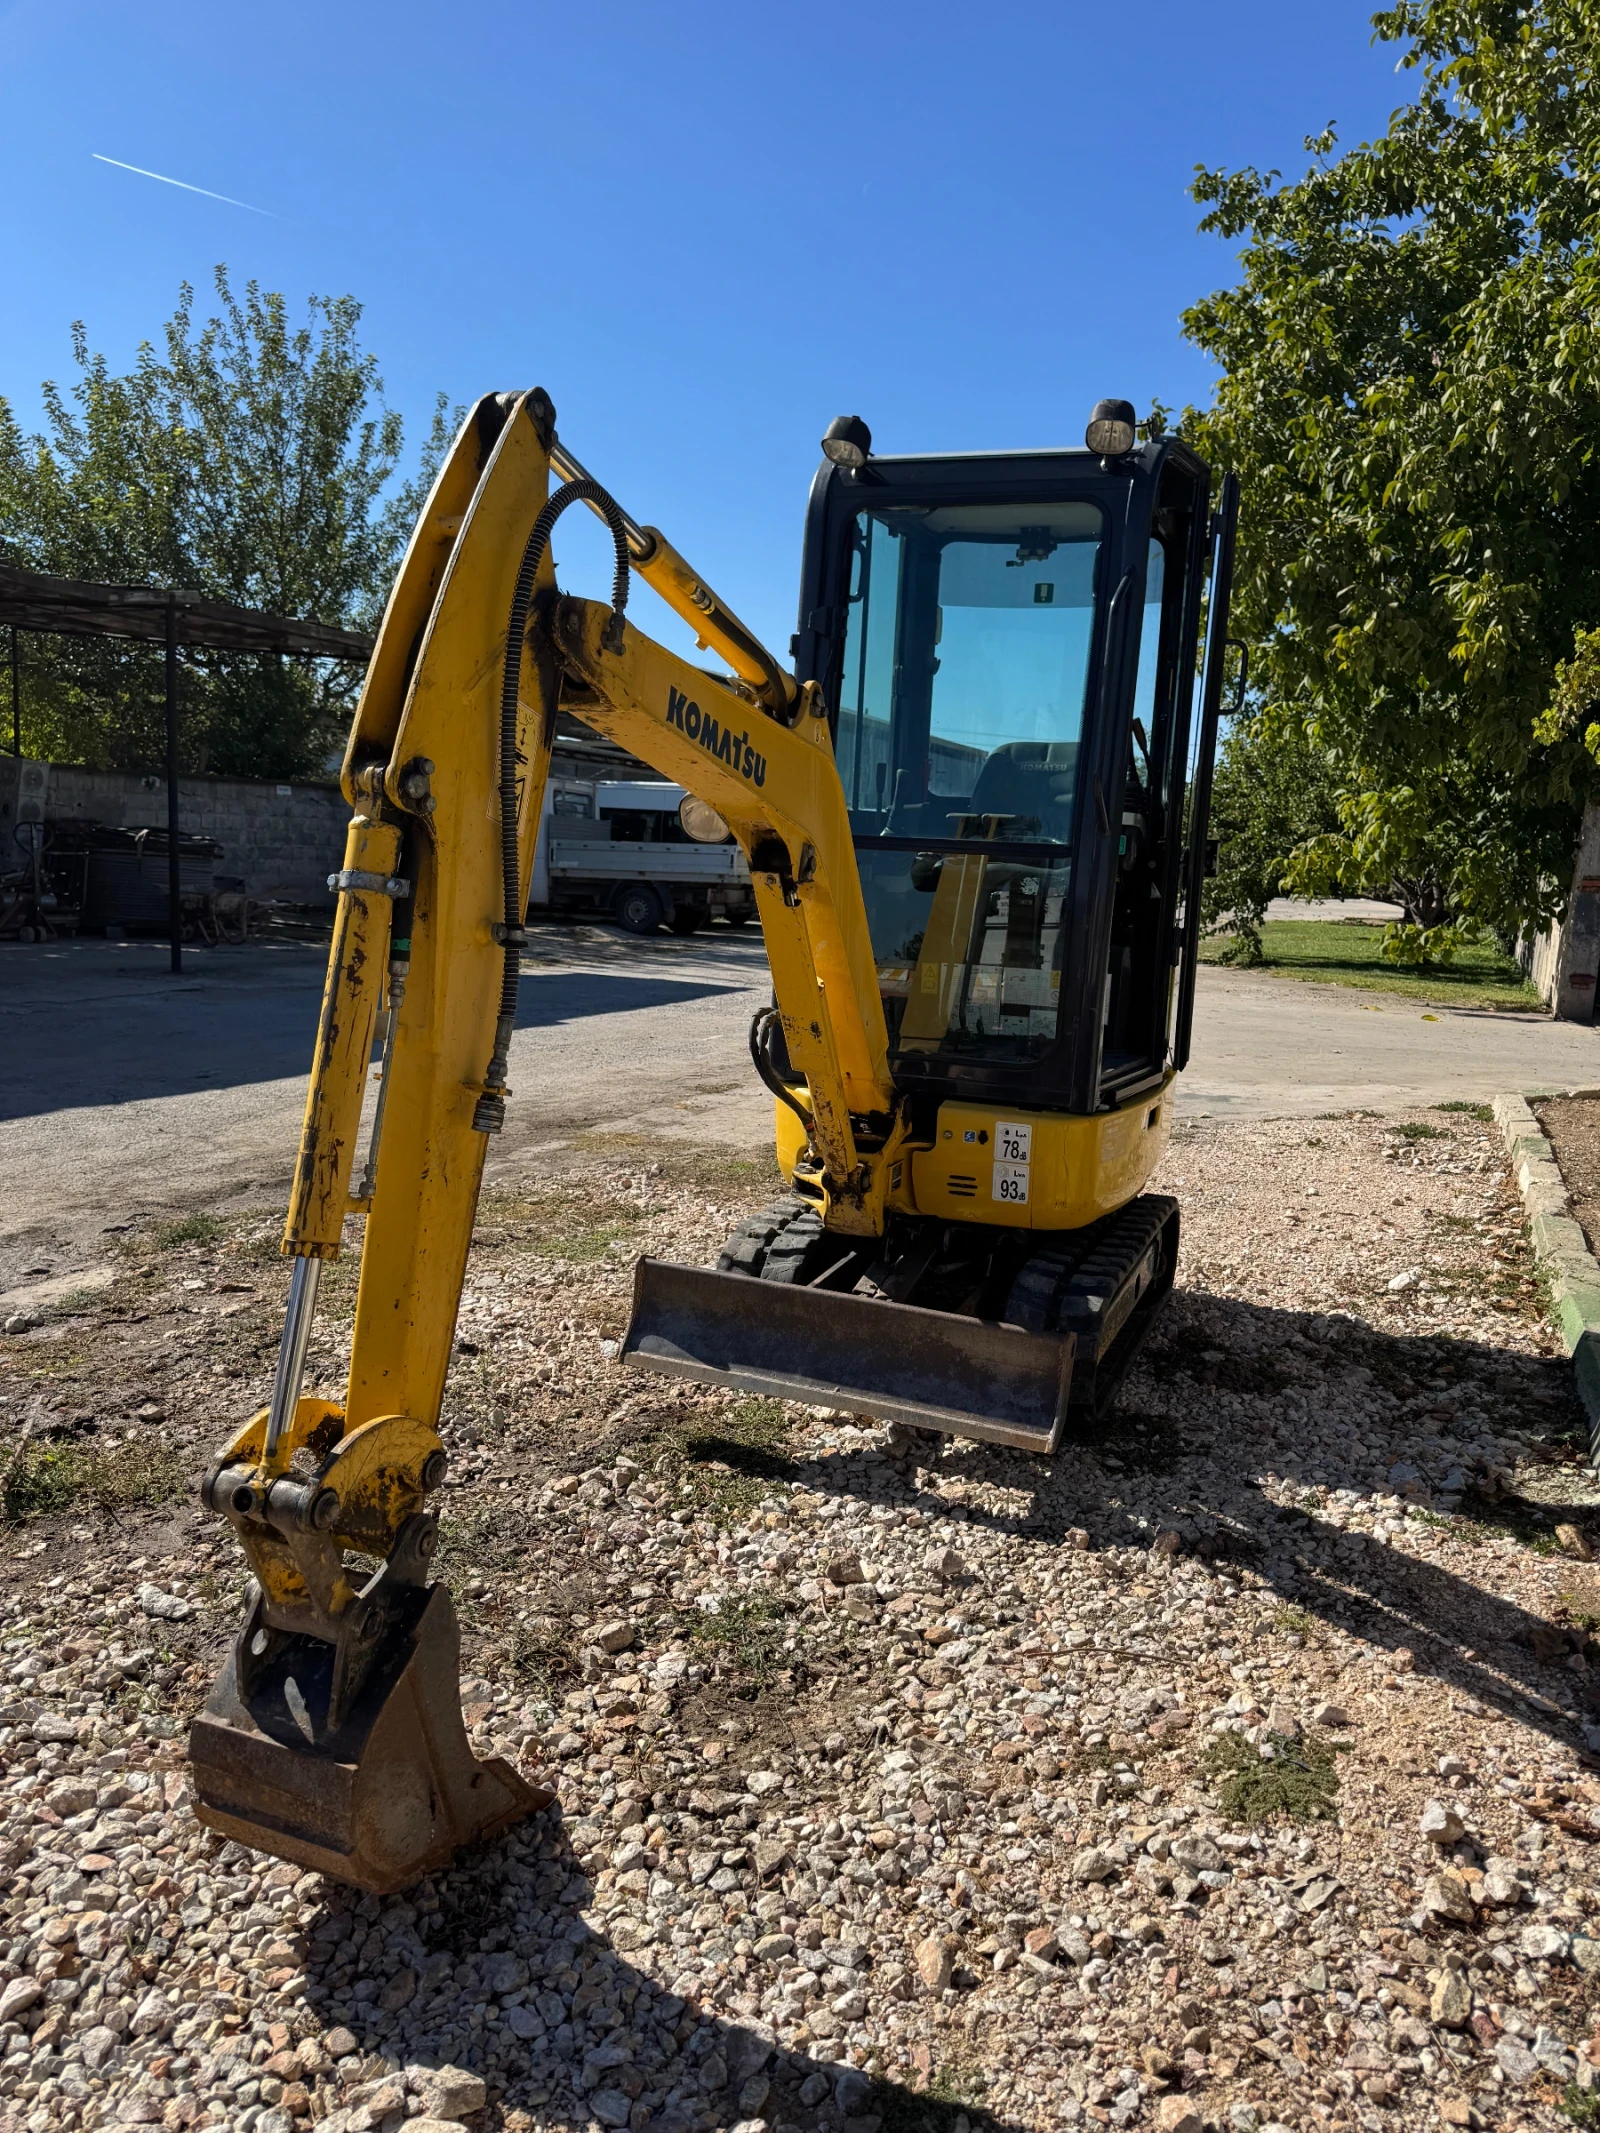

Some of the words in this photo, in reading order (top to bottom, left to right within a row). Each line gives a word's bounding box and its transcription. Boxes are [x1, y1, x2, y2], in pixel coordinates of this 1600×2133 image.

[666, 685, 766, 787] KOMATSU
[1020, 763, 1067, 772] KOMATSU
[1003, 1140, 1019, 1159] 78
[1000, 1179, 1018, 1199] 93
